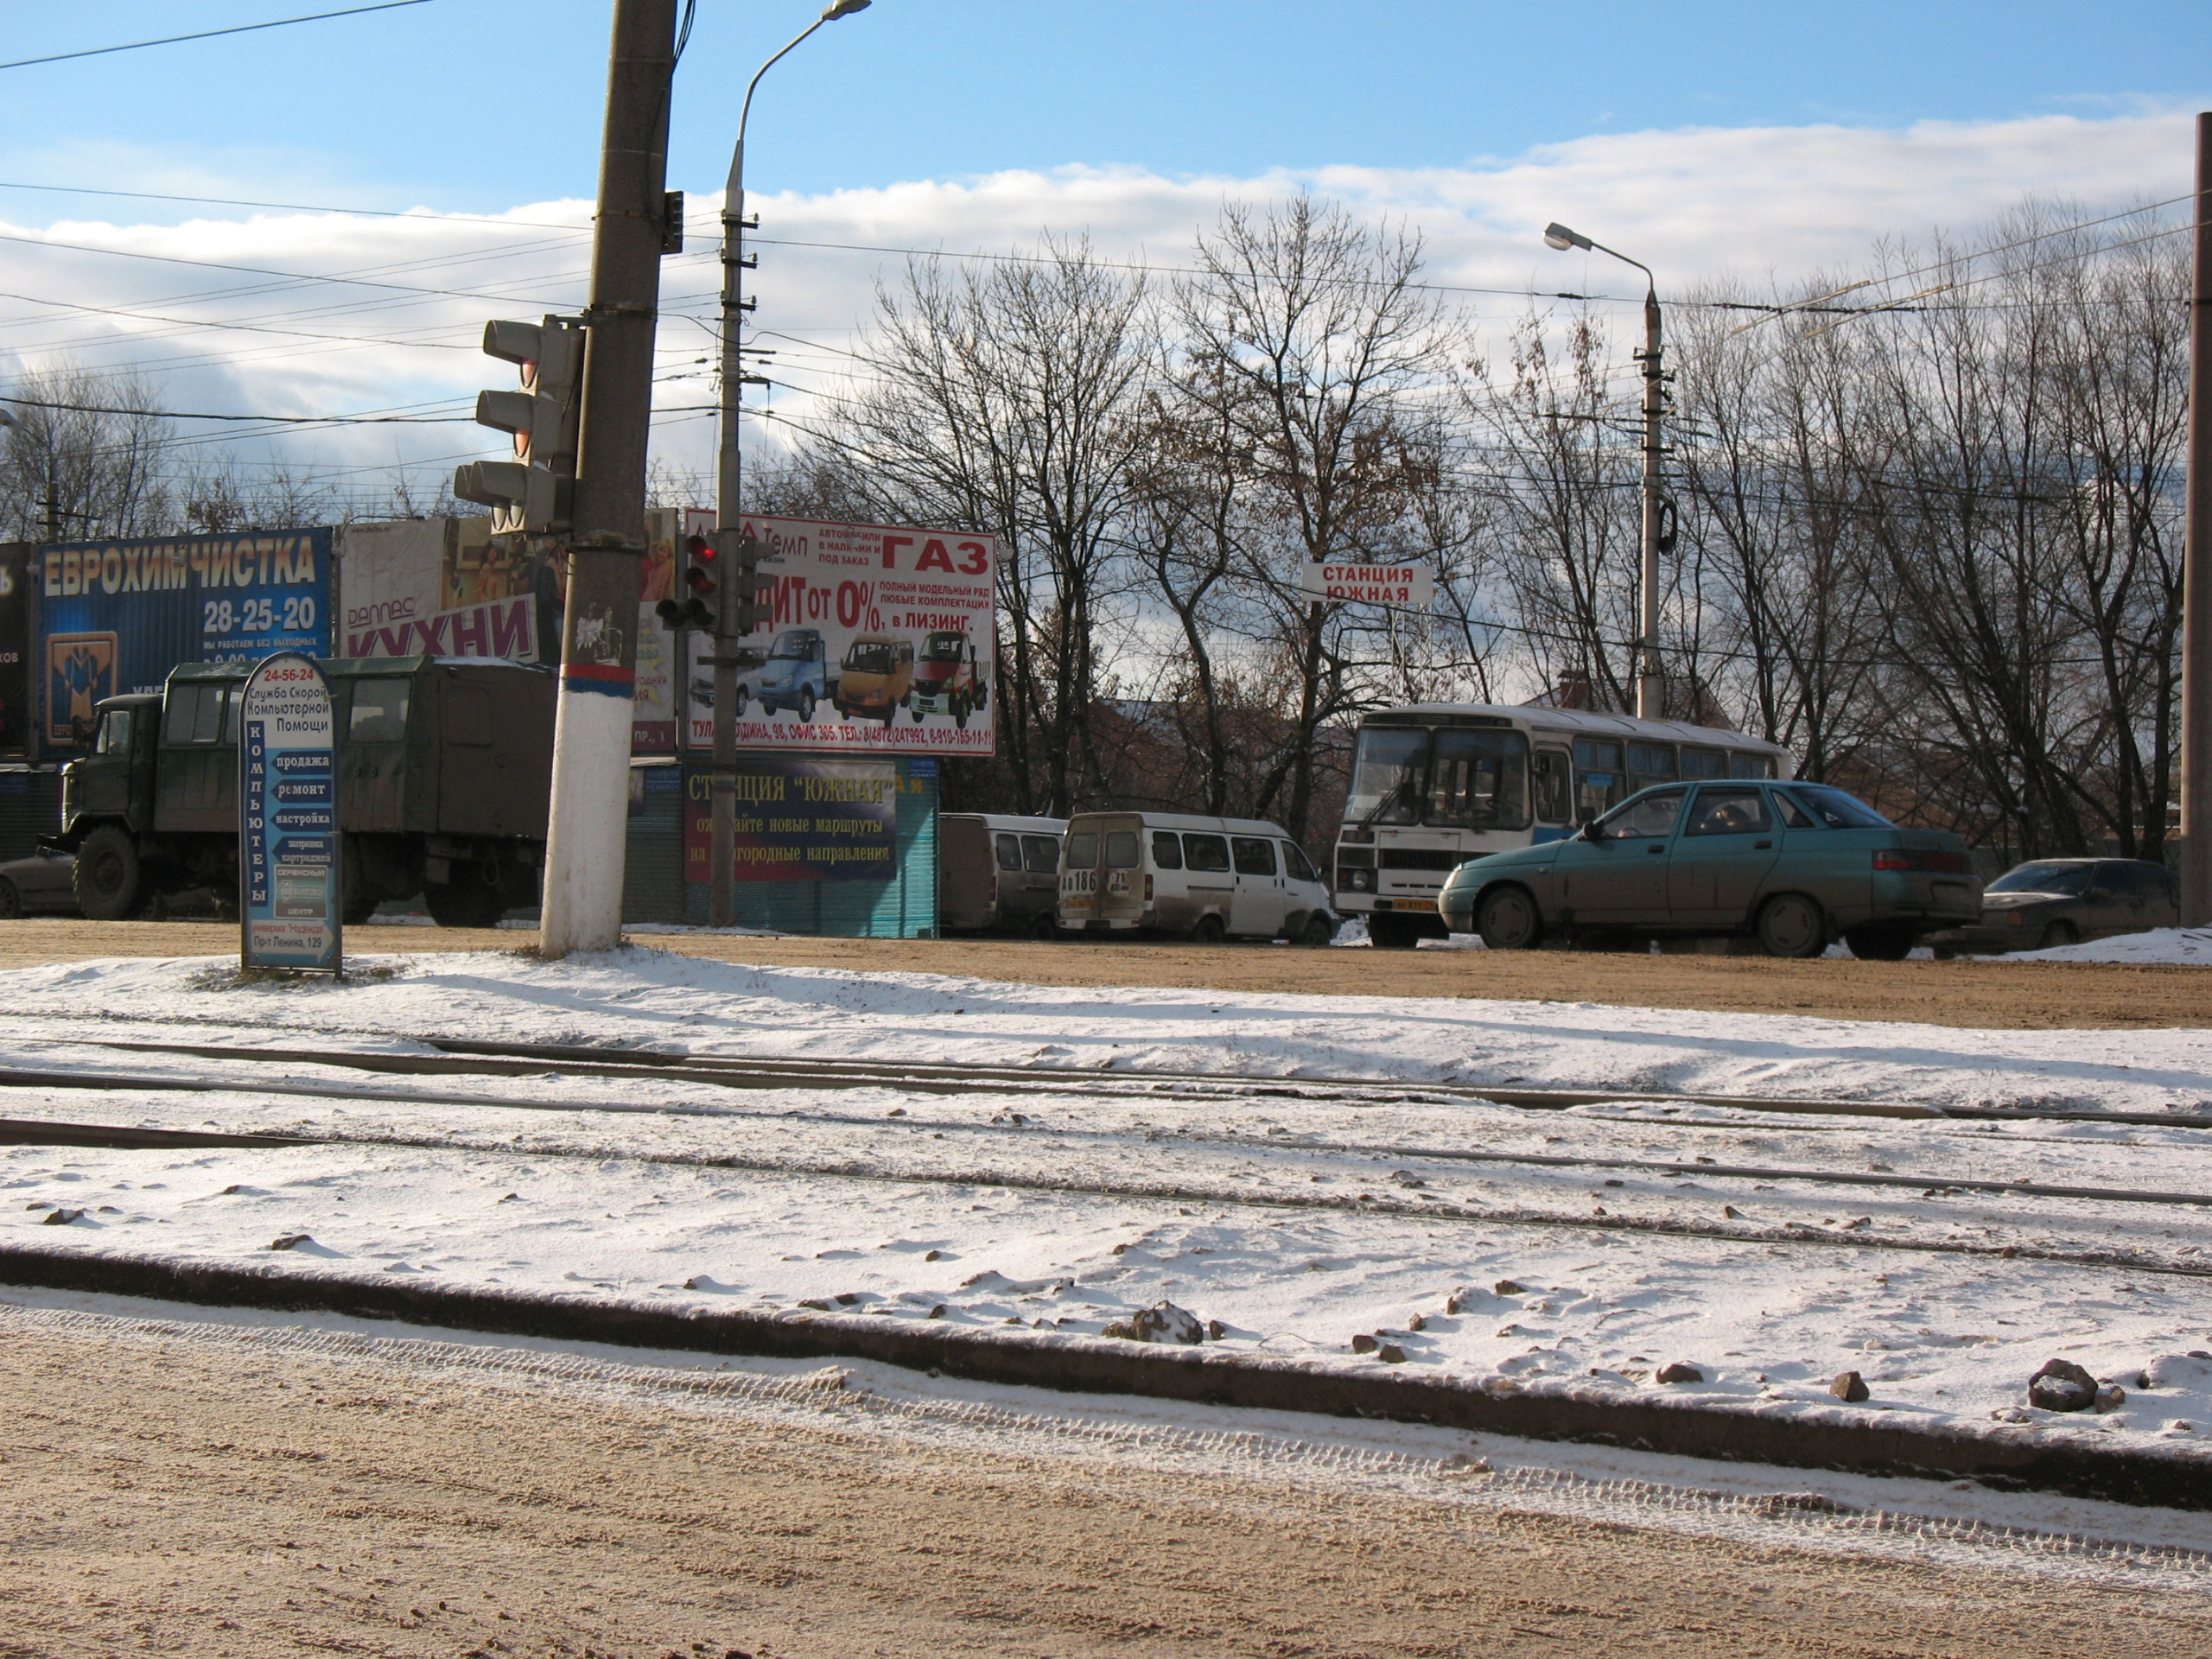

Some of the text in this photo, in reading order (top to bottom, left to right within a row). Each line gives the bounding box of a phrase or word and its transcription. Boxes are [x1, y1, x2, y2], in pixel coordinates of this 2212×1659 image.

[819, 529, 881, 542] АВТОМБИЛИ
[819, 554, 869, 566] ПОД ЗАКАЗ
[882, 535, 988, 575] ГАЗ
[44, 536, 316, 597] ЕВРОХИМЧИСТКА
[1322, 566, 1414, 584] СТАНЦИЯ
[880, 581, 989, 598] ПОЛНЫЙ МОДЕЛЬНЫЙ РЯД
[1326, 585, 1408, 601] ЮЖНАЯ
[755, 575, 806, 633] ДИТ
[905, 612, 974, 632] ЛИЗИНГ.
[880, 594, 989, 610] ЛЮБЫЕ КОМПЛЕКТАЦИИ
[204, 597, 316, 632] 28-25-20
[218, 639, 253, 649] РАБОТАЕМ
[257, 639, 270, 647] БЕЗ
[273, 637, 317, 648] ВЫХОДНЫХ
[264, 668, 315, 682] 24-56-24
[635, 676, 667, 686] ГОДНЯЯ
[249, 686, 327, 702] Служба Скорой
[247, 701, 329, 718] Компьютерной
[276, 717, 328, 733] Помощи
[692, 721, 714, 737] ТУЛ
[736, 721, 772, 743] ЛДИНА,
[789, 724, 817, 741] ОФИС
[276, 756, 330, 770] продажа
[277, 784, 326, 798] ремонт
[689, 774, 785, 806] СТНЦИЯ
[276, 812, 330, 826] настройка
[696, 813, 883, 836] ожайте новые маршруты
[287, 839, 324, 849] заправка
[281, 852, 332, 863] картриджей
[691, 847, 890, 865] на городные направления
[1075, 870, 1096, 891] 186
[254, 936, 322, 949] Пр-т Ленина, 129
